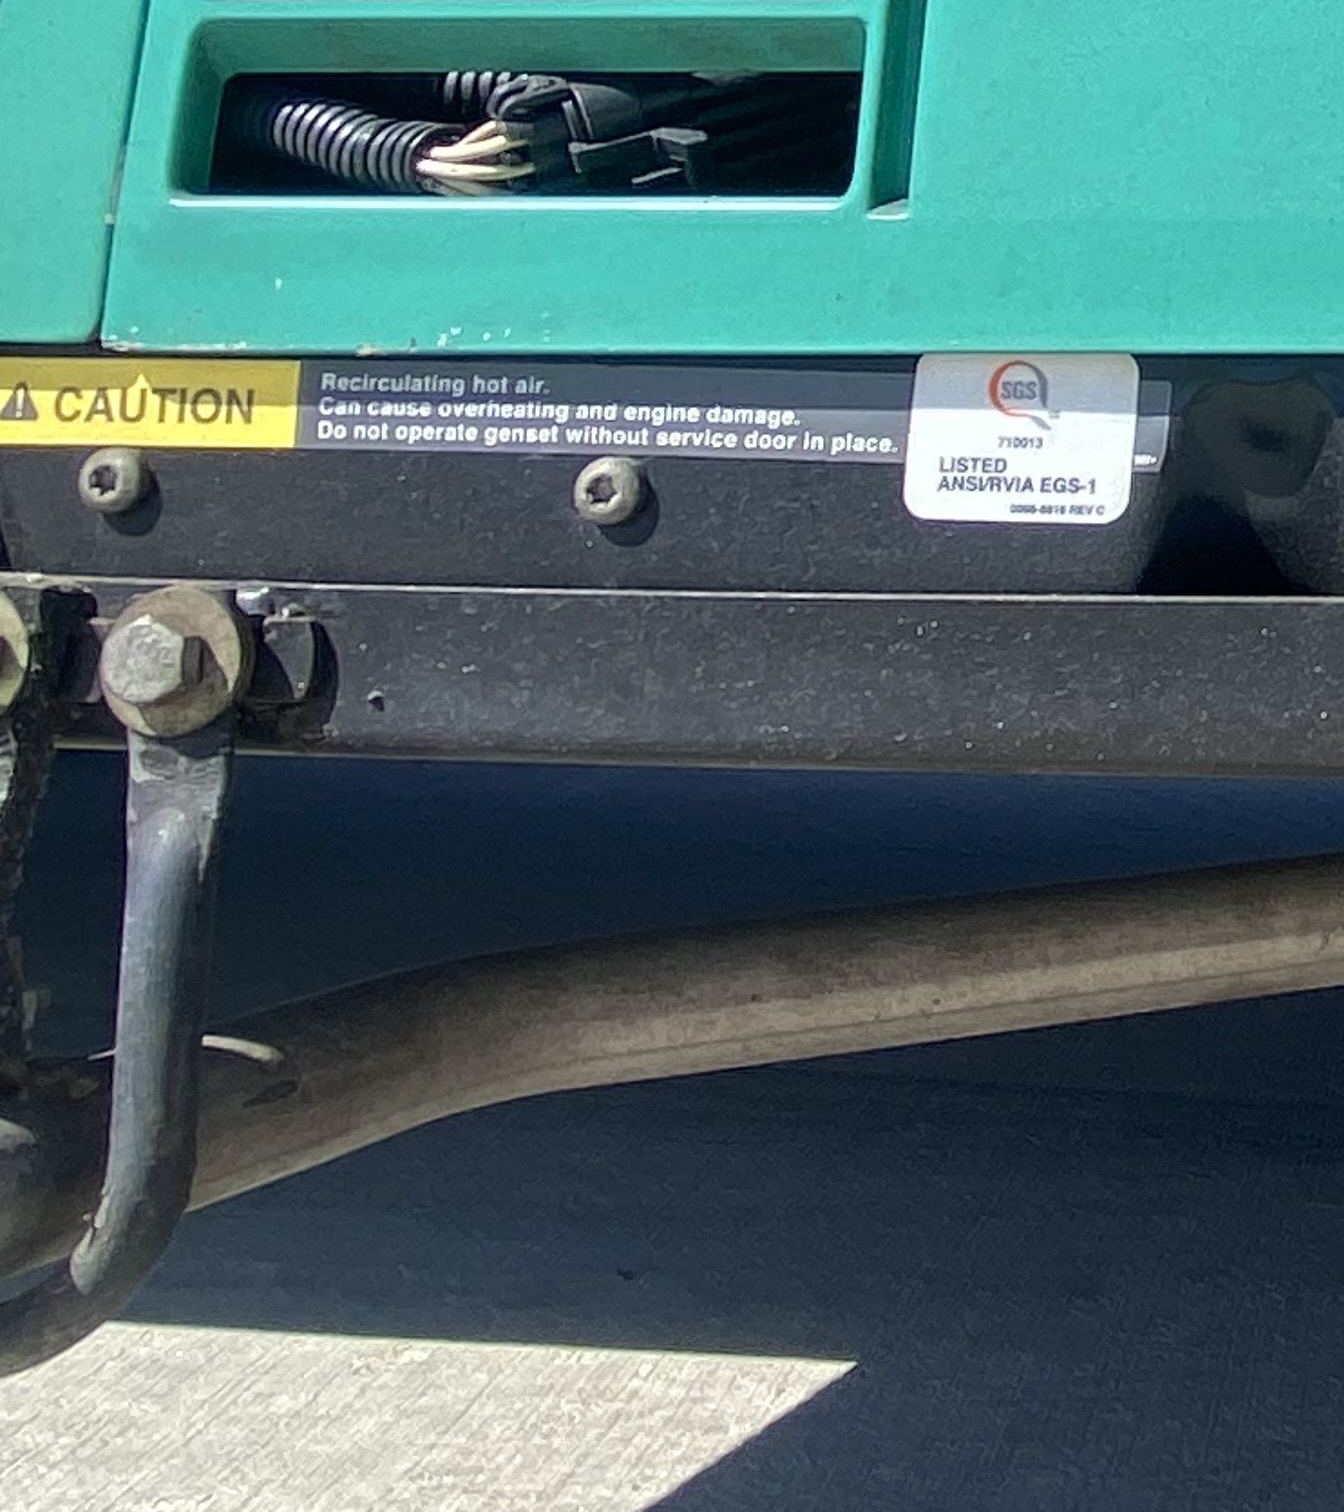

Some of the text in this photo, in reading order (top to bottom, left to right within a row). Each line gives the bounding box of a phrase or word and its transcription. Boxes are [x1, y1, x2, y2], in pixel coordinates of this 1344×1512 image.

[321, 373, 550, 397] Recirculating hot air.
[1001, 381, 1037, 400] SGS
[55, 387, 255, 425] CAUTION
[319, 396, 801, 429] Can cause overheating and engine damage.
[318, 420, 898, 455] Do not operate genset without service door in place.
[939, 456, 1007, 473] LISTED
[1041, 477, 1095, 494] EGS-1
